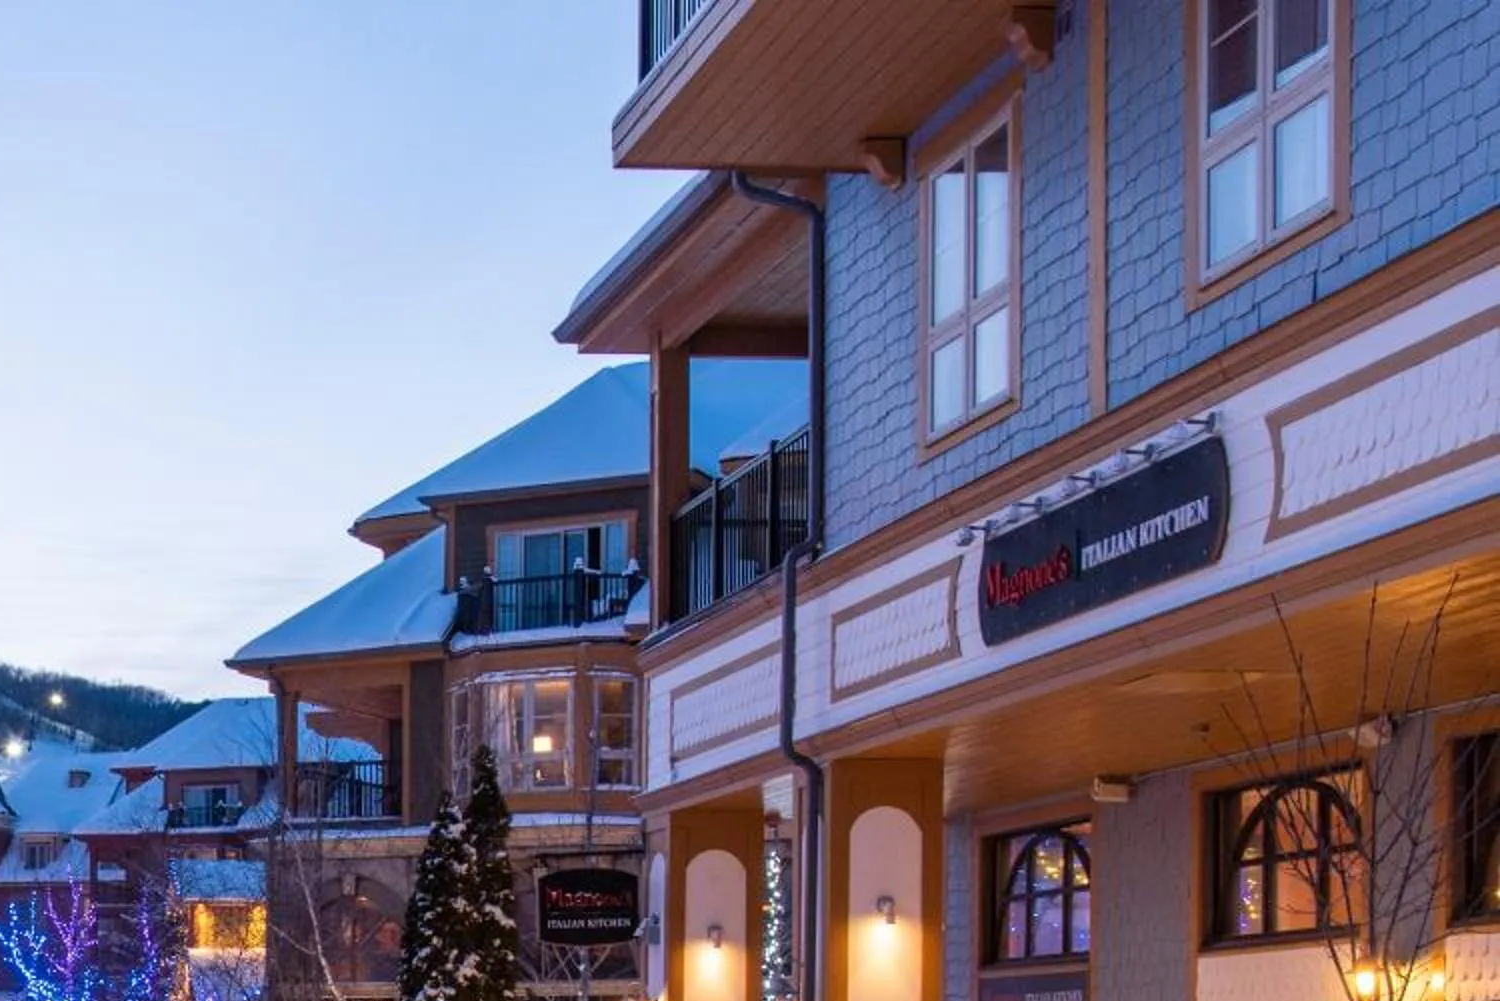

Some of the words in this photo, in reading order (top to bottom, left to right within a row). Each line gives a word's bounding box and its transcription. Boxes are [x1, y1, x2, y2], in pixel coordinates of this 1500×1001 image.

[1081, 525, 1138, 571] ITALIAN
[1139, 495, 1209, 548] KITCHEN
[547, 919, 585, 929] ITALIAN
[587, 918, 631, 929] KITCHEN
